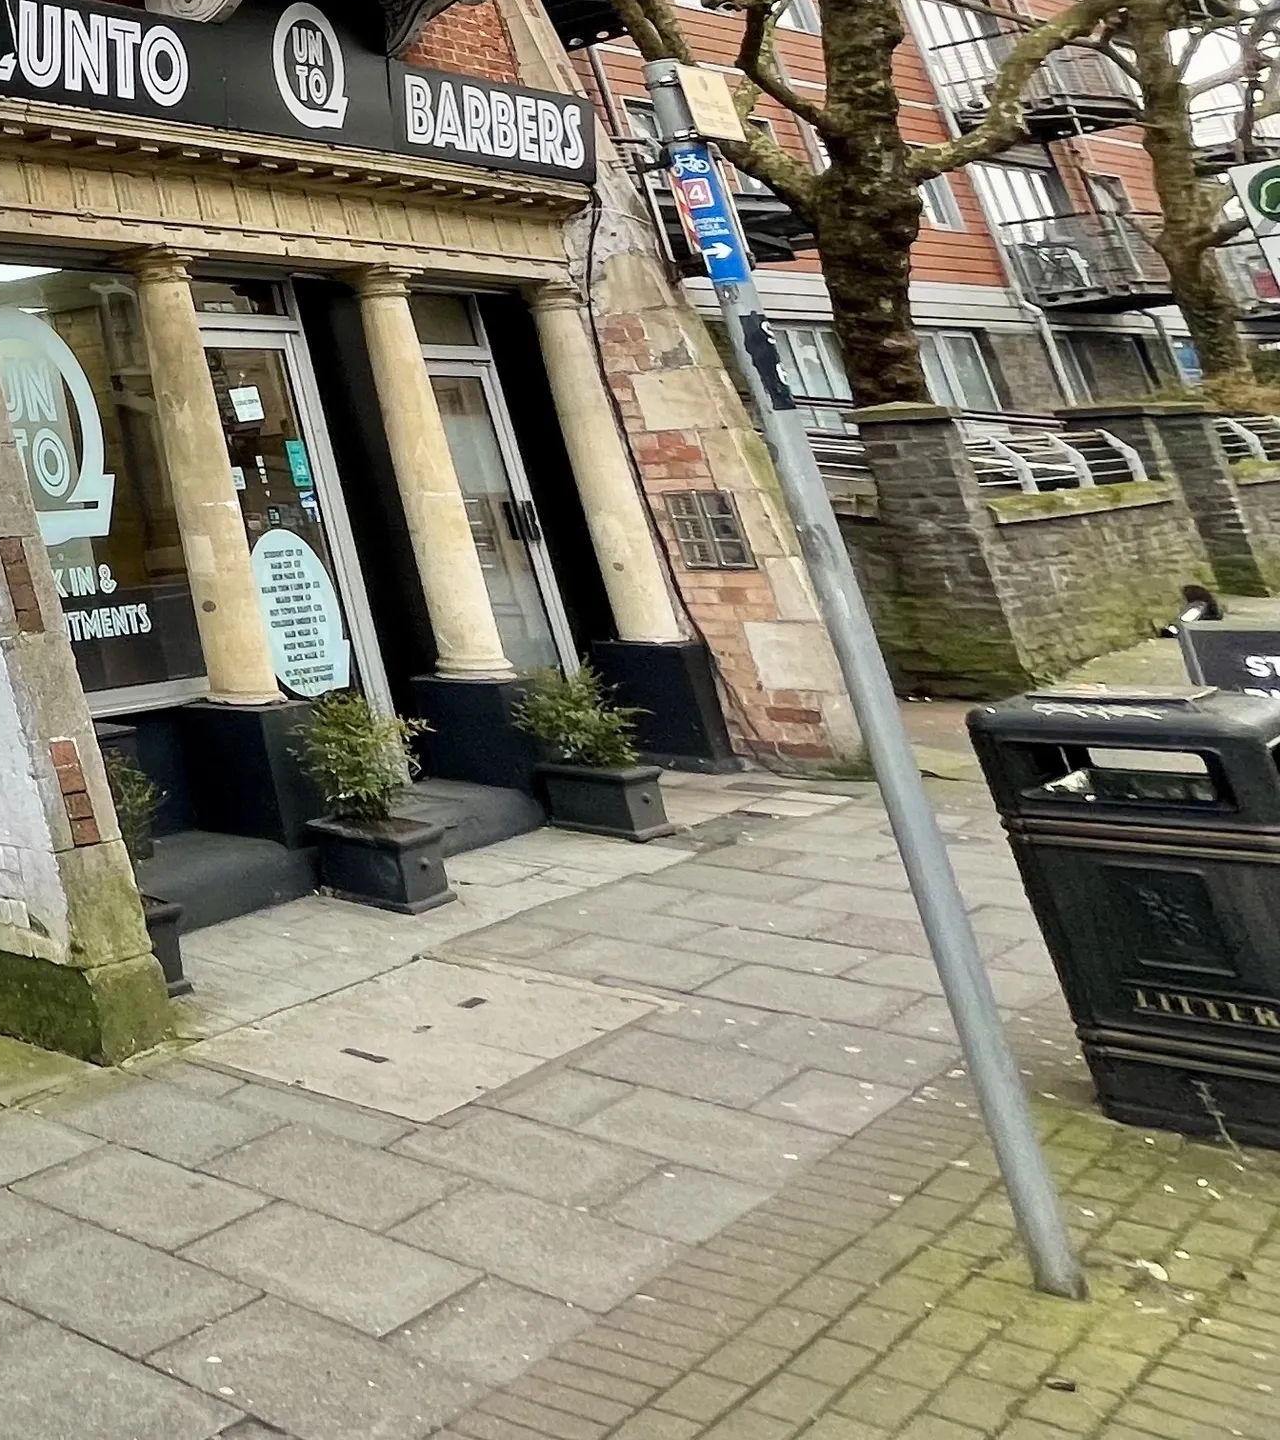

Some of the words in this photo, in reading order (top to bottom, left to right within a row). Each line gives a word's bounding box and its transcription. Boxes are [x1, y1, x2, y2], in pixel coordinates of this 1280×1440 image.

[292, 26, 325, 67] UN
[296, 65, 328, 105] TO
[403, 72, 586, 170] BARBERS
[689, 184, 707, 202] 4
[69, 565, 96, 597] IN
[99, 563, 118, 594] &
[1133, 988, 1280, 1028] LITTER
